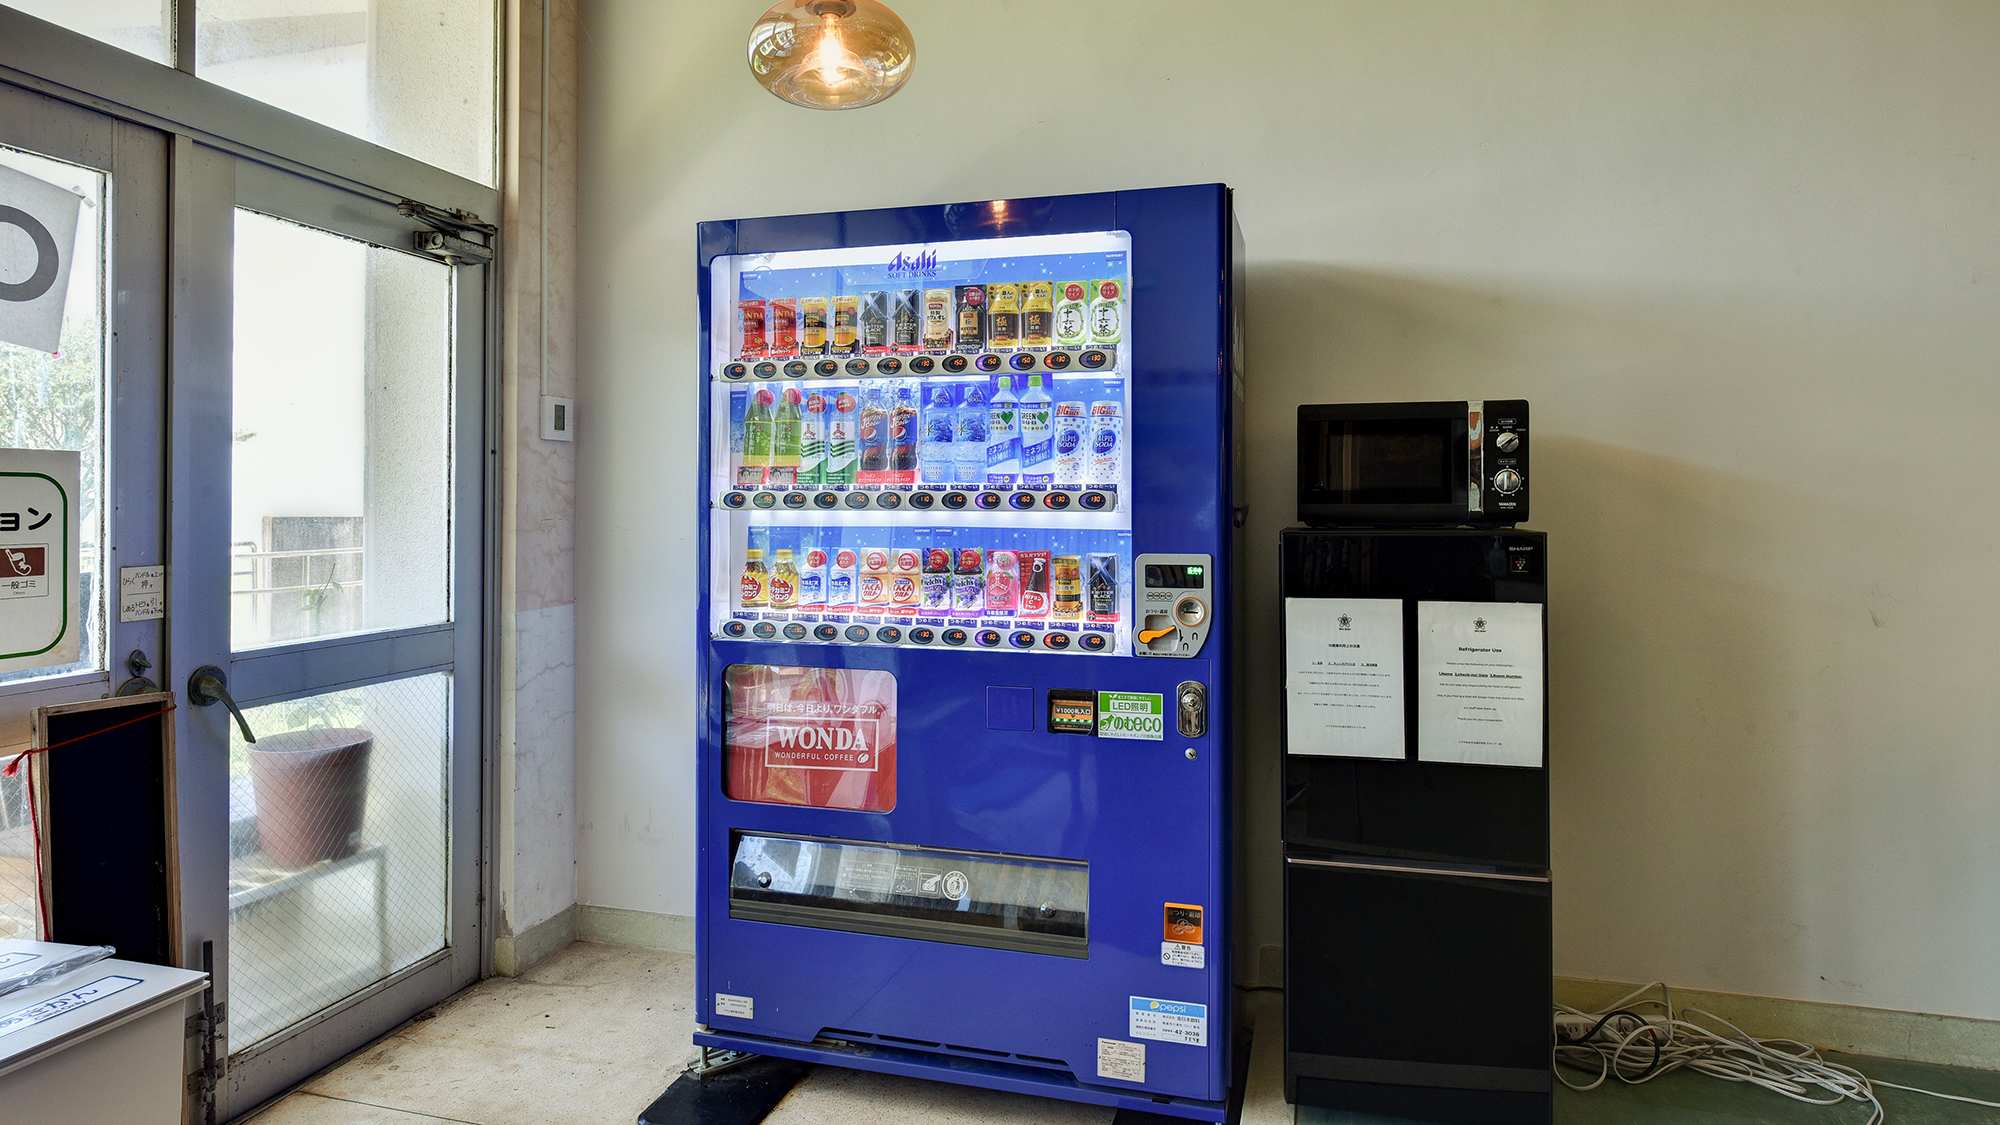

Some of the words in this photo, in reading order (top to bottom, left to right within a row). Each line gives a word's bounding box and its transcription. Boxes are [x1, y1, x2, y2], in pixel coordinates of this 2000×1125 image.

[888, 249, 937, 271] Asahi
[909, 270, 937, 278] DRINKS
[996, 316, 1007, 326] 極
[1029, 314, 1040, 324] 極
[1062, 309, 1075, 337] 十六茶
[1096, 307, 1110, 335] 十六茶
[1056, 406, 1070, 415] BIG
[1092, 406, 1106, 415] BIG
[1, 580, 37, 589] 一般ゴミ
[767, 703, 881, 716] 明日は、今日より、ワンダフル。
[1112, 702, 1148, 712] LED照明
[1114, 716, 1162, 732] のむeco
[777, 726, 868, 751] WONDA
[774, 751, 821, 760] WONDERFUL
[824, 754, 854, 762] COFFEE
[1160, 1004, 1186, 1013] pepsi
